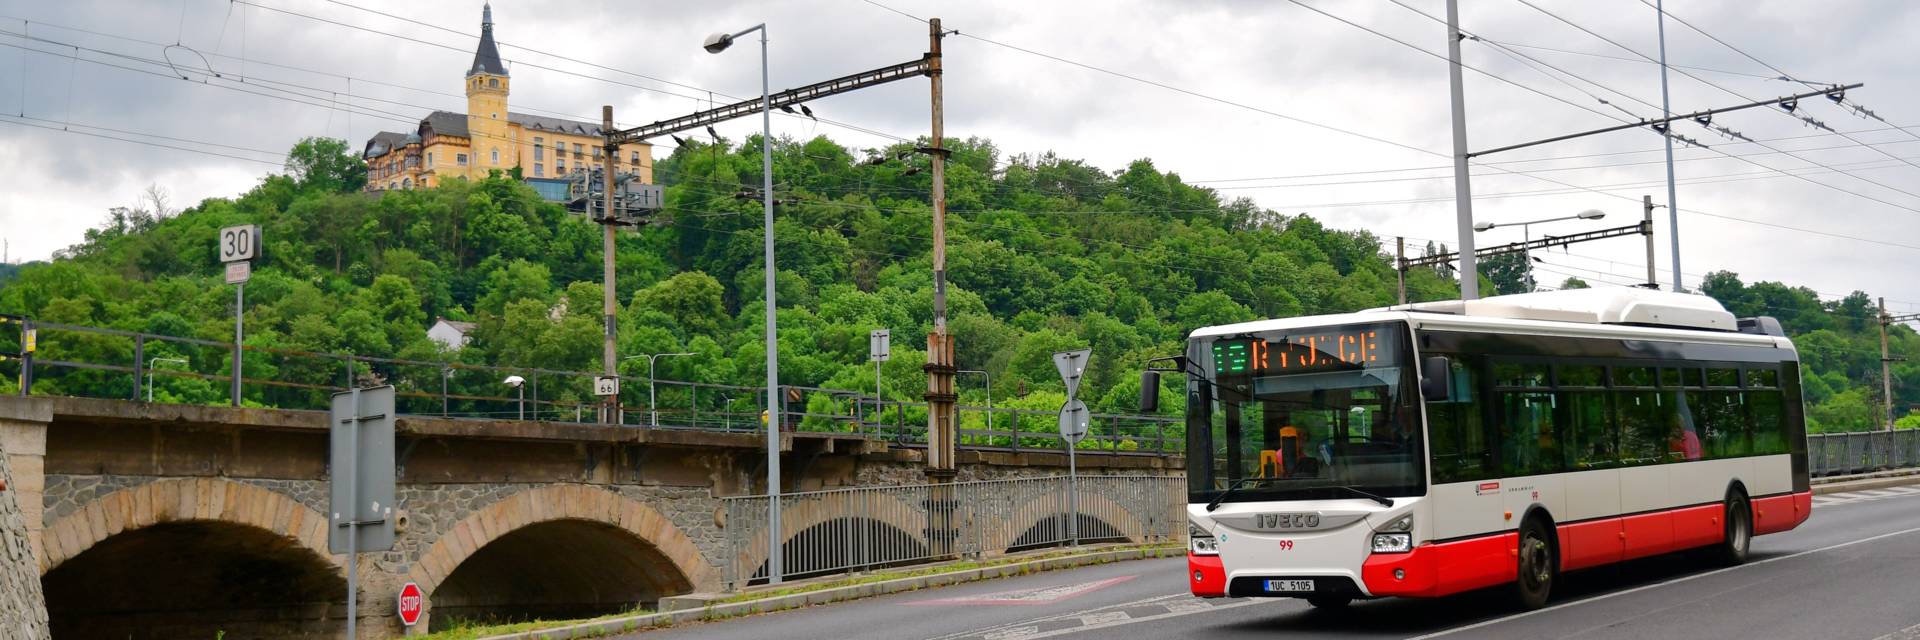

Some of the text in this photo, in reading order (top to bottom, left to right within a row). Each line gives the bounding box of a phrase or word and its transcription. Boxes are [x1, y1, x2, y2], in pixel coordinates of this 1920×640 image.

[225, 229, 249, 257] 30
[600, 383, 613, 393] 66
[1256, 513, 1320, 529] IVECO
[1279, 540, 1294, 551] 99
[1270, 581, 1311, 591] 1UC 5105
[402, 595, 420, 612] STOP
